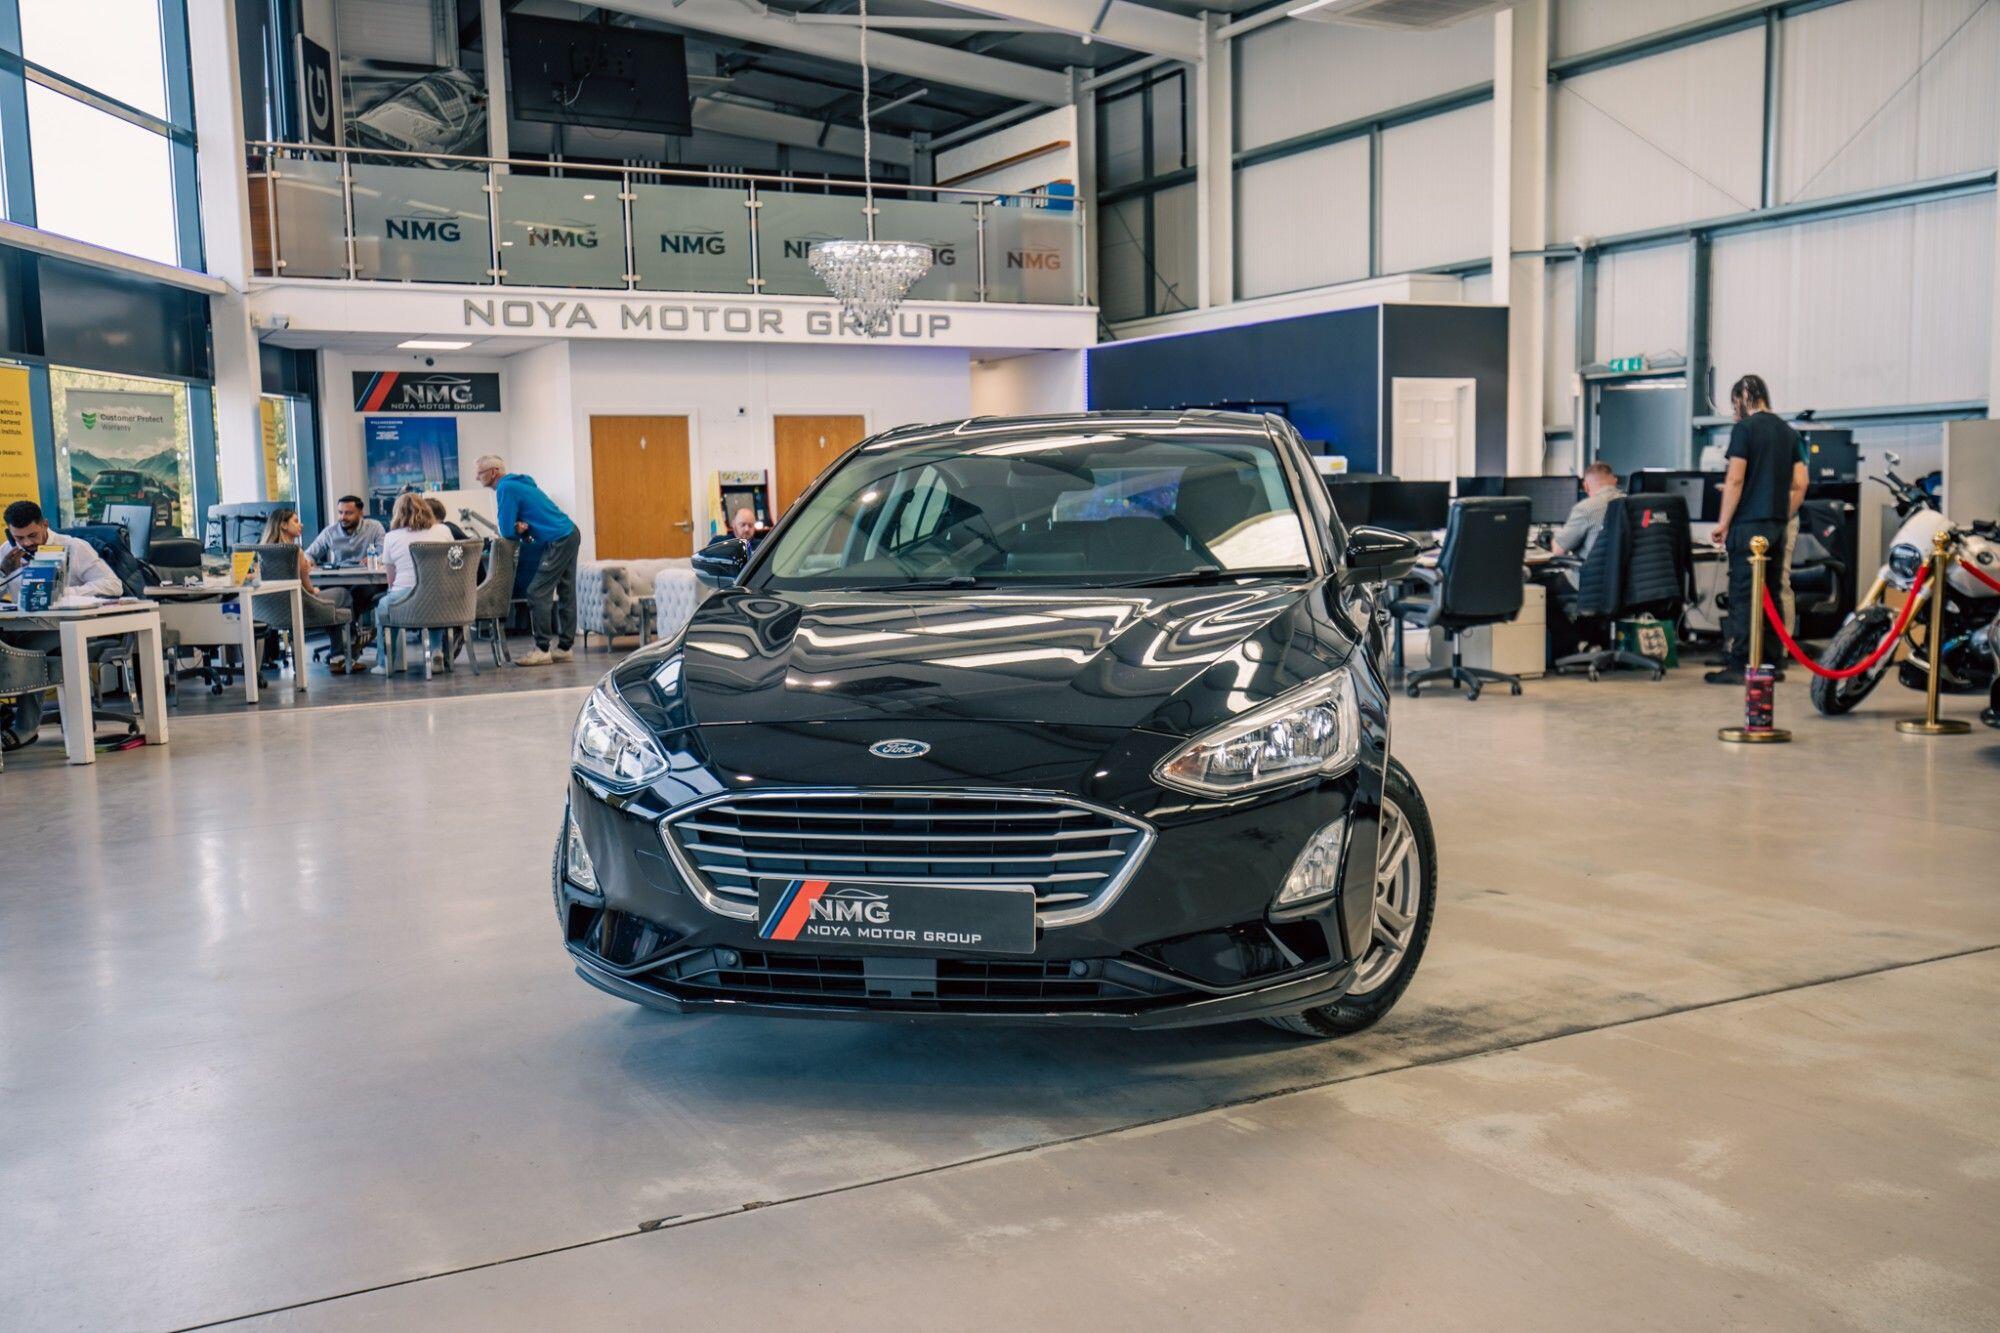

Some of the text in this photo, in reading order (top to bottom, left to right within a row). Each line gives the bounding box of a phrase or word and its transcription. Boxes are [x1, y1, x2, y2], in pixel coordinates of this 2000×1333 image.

[386, 219, 461, 242] NMG
[528, 227, 599, 249] NMG
[660, 234, 726, 255] NMG
[1006, 250, 1061, 270] NMG
[463, 299, 597, 329] NOYA
[620, 303, 784, 333] MOTOR
[402, 384, 474, 404] NMG
[454, 403, 486, 411] GROUP
[100, 413, 164, 424] Customer Protect
[102, 424, 131, 432] Warranty
[882, 743, 916, 753] Ford
[808, 898, 891, 924] NMG
[807, 925, 983, 944] NOYA MOTOR GROUP
